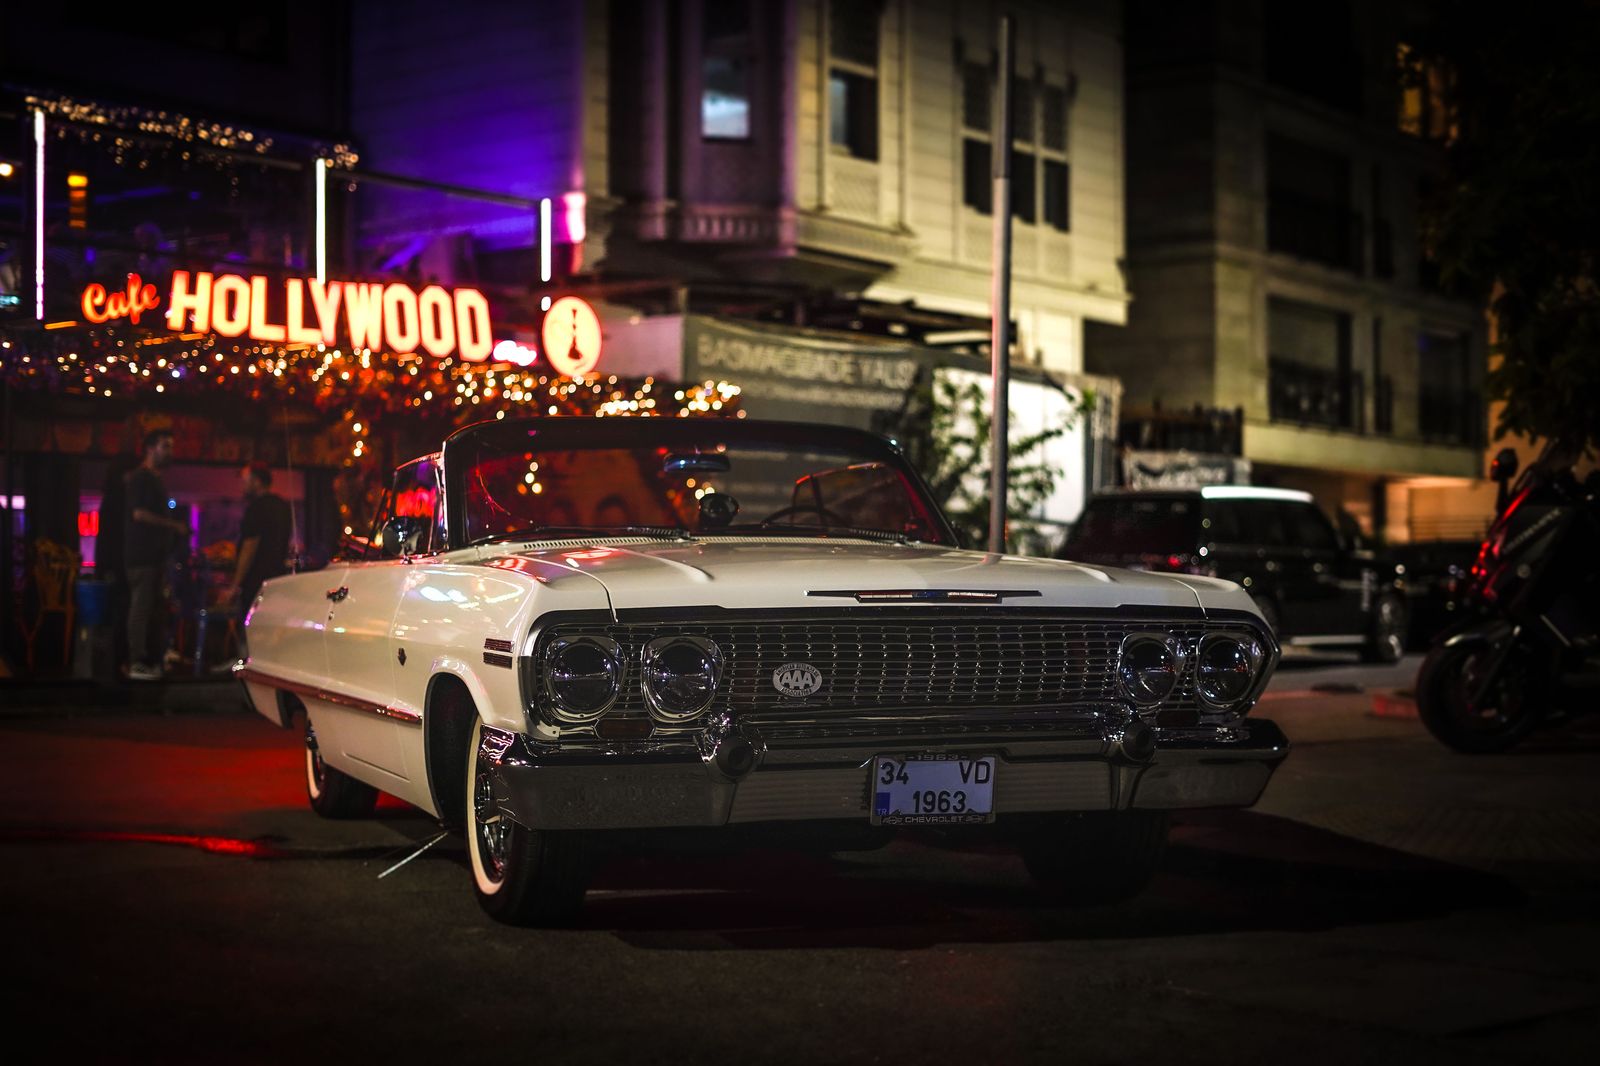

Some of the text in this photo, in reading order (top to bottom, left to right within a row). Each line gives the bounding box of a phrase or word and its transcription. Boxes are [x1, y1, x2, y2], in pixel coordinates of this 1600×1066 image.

[82, 270, 493, 363] Cafe HOLLYWOOD
[782, 670, 813, 689] AAA
[881, 761, 990, 785] 34 VD
[913, 791, 967, 813] 1963
